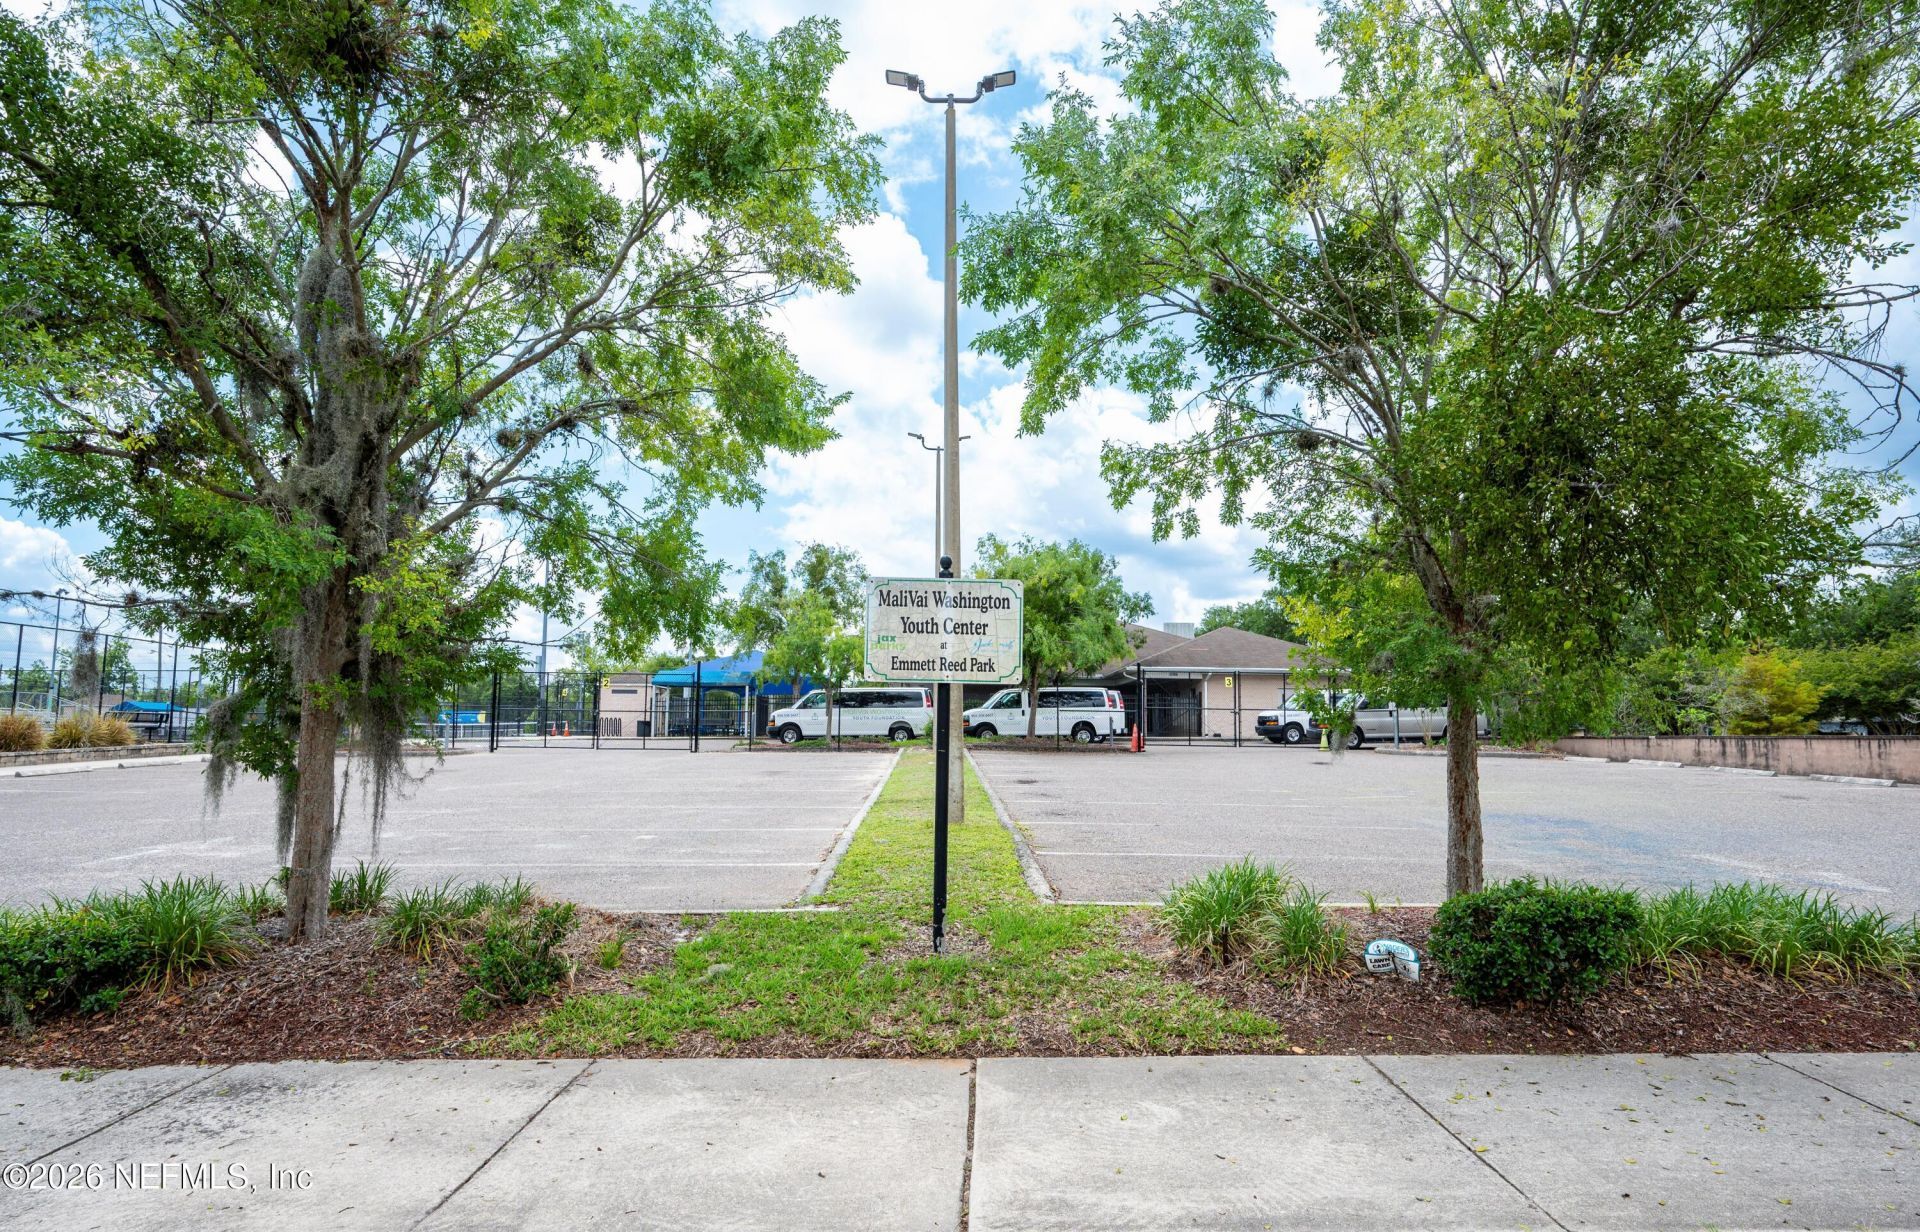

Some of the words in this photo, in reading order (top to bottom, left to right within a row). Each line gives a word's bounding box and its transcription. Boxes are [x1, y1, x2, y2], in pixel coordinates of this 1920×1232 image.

[878, 589, 928, 608] MaliVai
[932, 590, 1011, 613] Washington
[900, 616, 940, 634] Youth
[943, 617, 989, 636] Center
[940, 641, 948, 650] at
[891, 655, 937, 672] Emmett
[939, 657, 967, 672] Reed
[970, 657, 996, 673] Park
